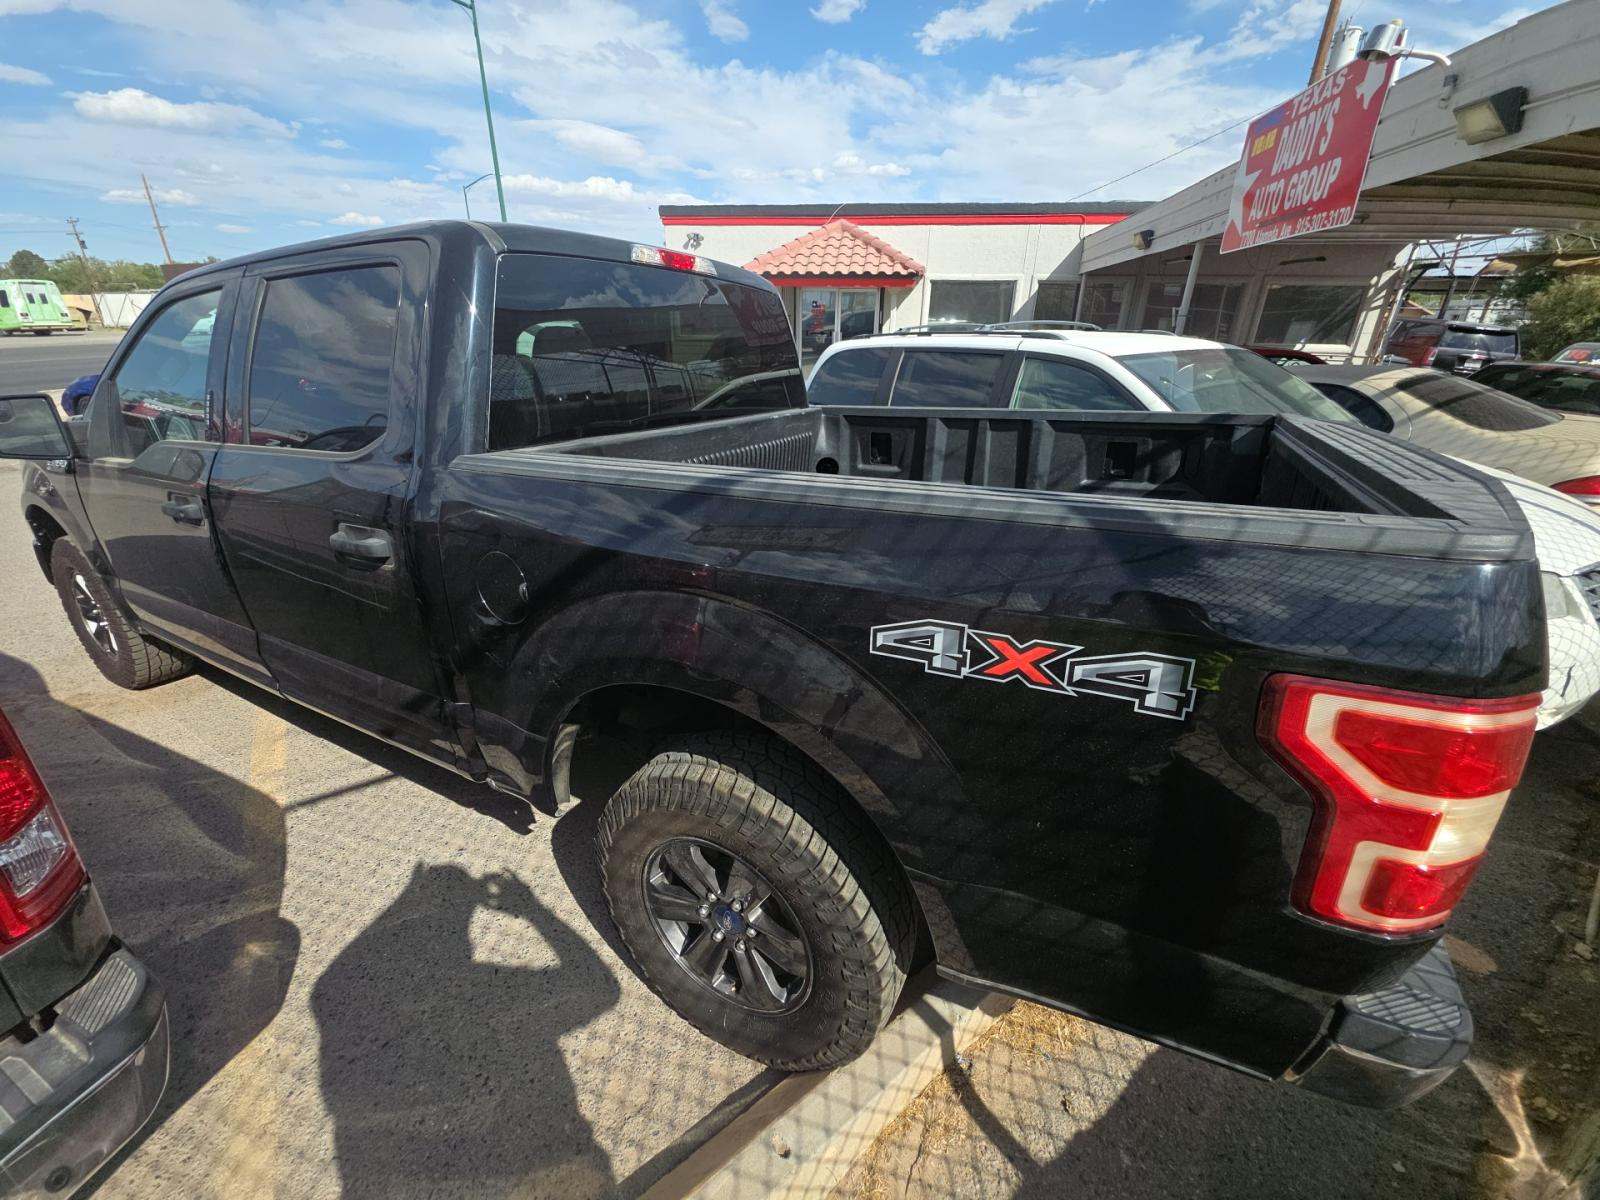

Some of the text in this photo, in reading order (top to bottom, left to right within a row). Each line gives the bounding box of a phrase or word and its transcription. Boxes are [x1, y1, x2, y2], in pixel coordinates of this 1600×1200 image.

[1271, 97, 1341, 176] DADDY'S
[1248, 156, 1342, 222] AUTO GROUP
